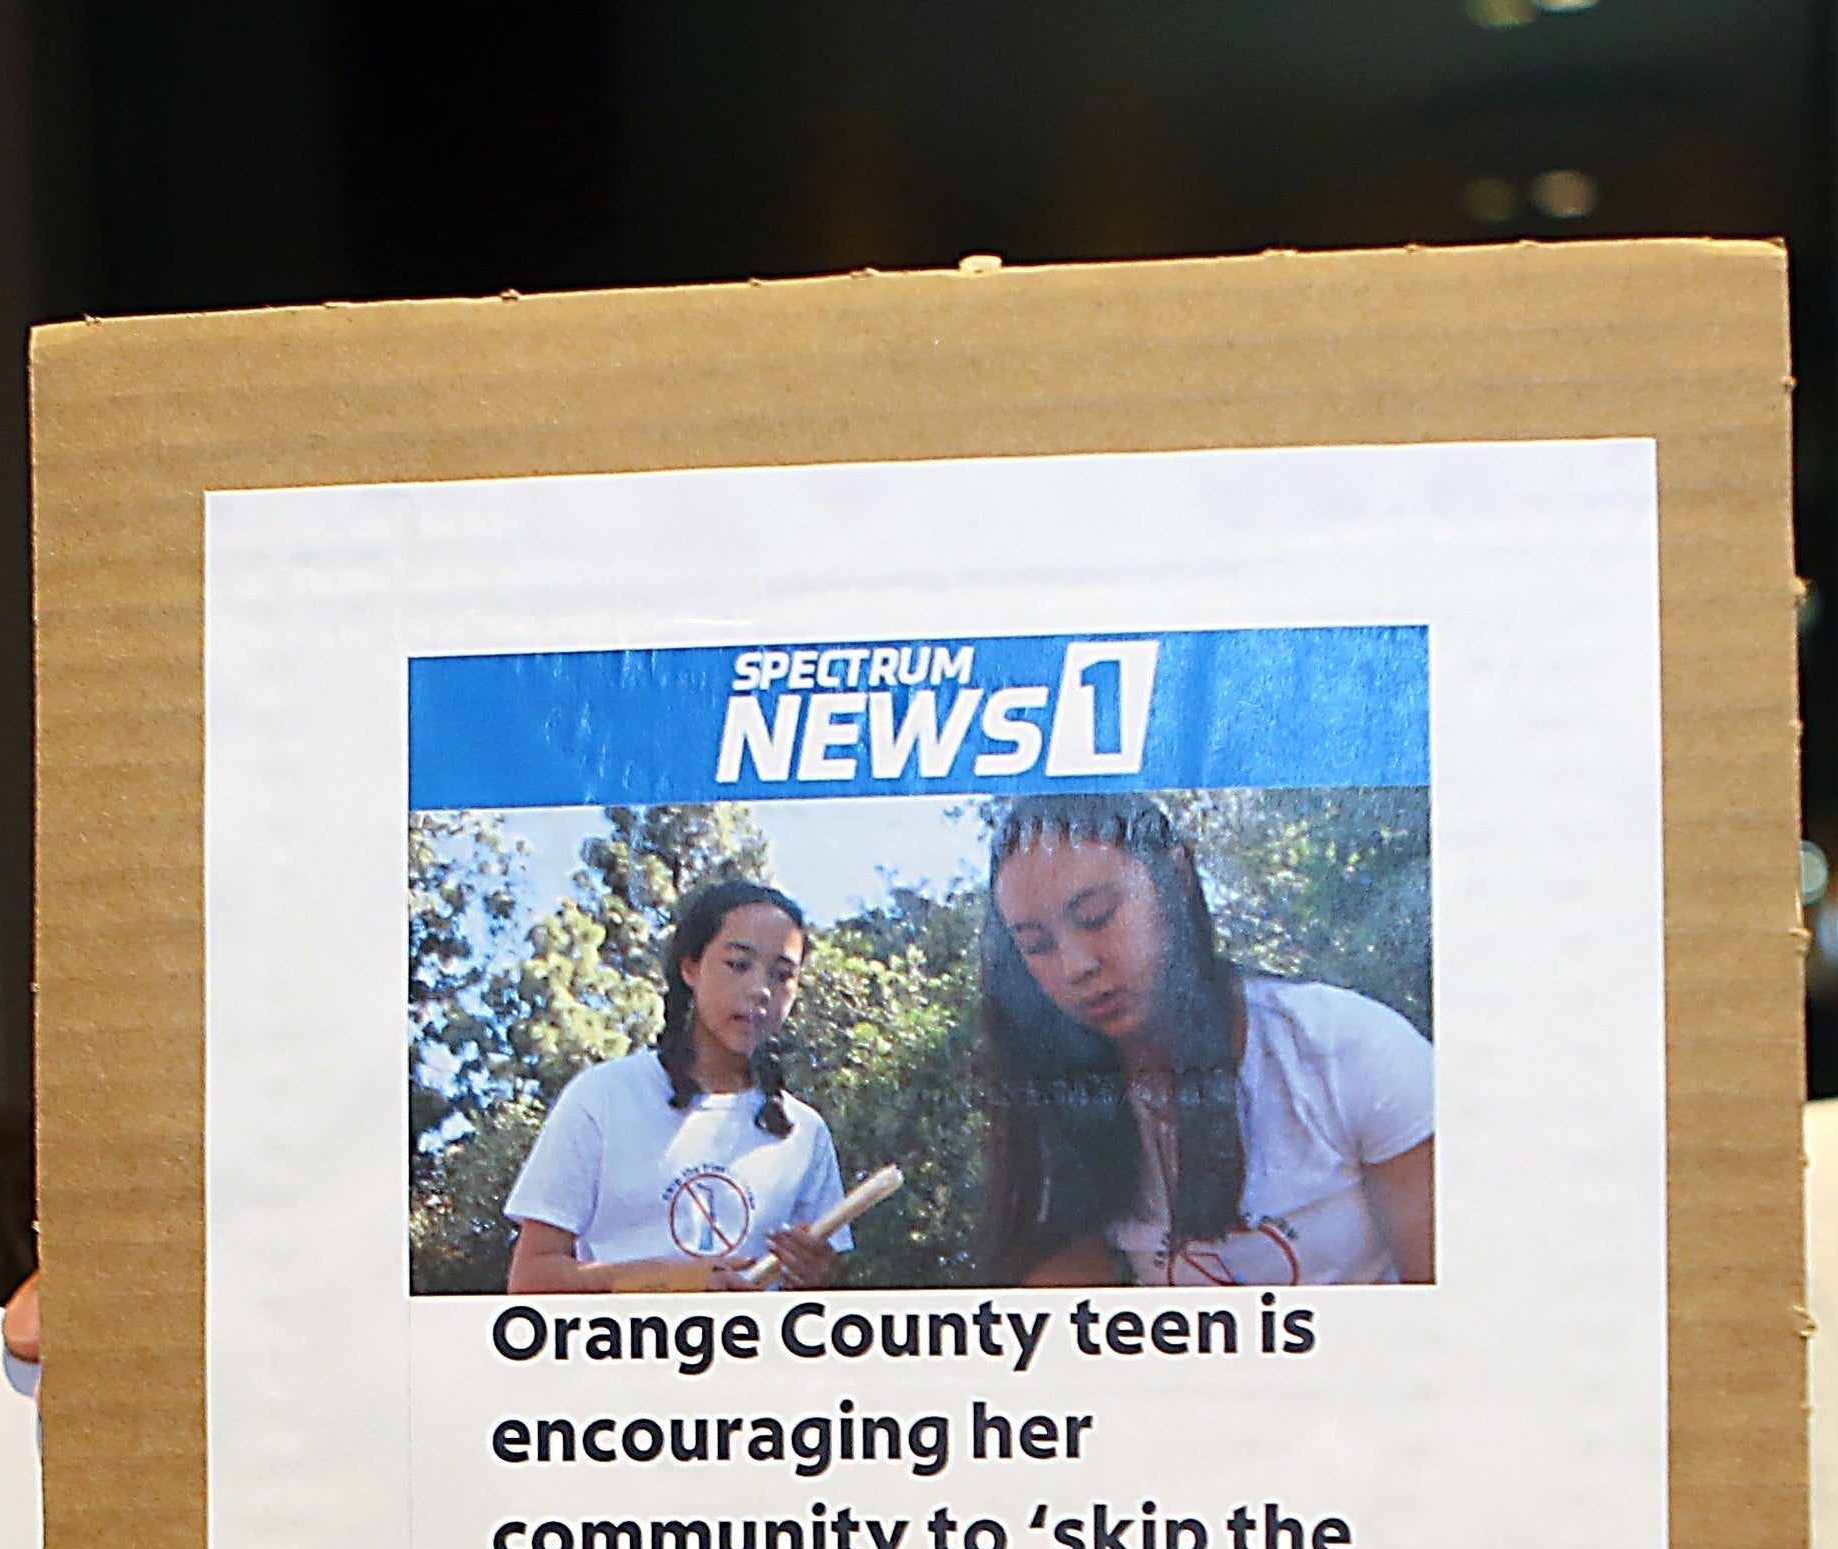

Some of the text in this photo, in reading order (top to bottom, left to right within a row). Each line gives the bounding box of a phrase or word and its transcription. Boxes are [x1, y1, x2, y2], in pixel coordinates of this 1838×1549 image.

[732, 645, 976, 691] SPECTRUM
[714, 686, 1051, 784] NEWS
[492, 1292, 1316, 1376] Orange County teen is
[492, 1398, 1094, 1477] encouraging her
